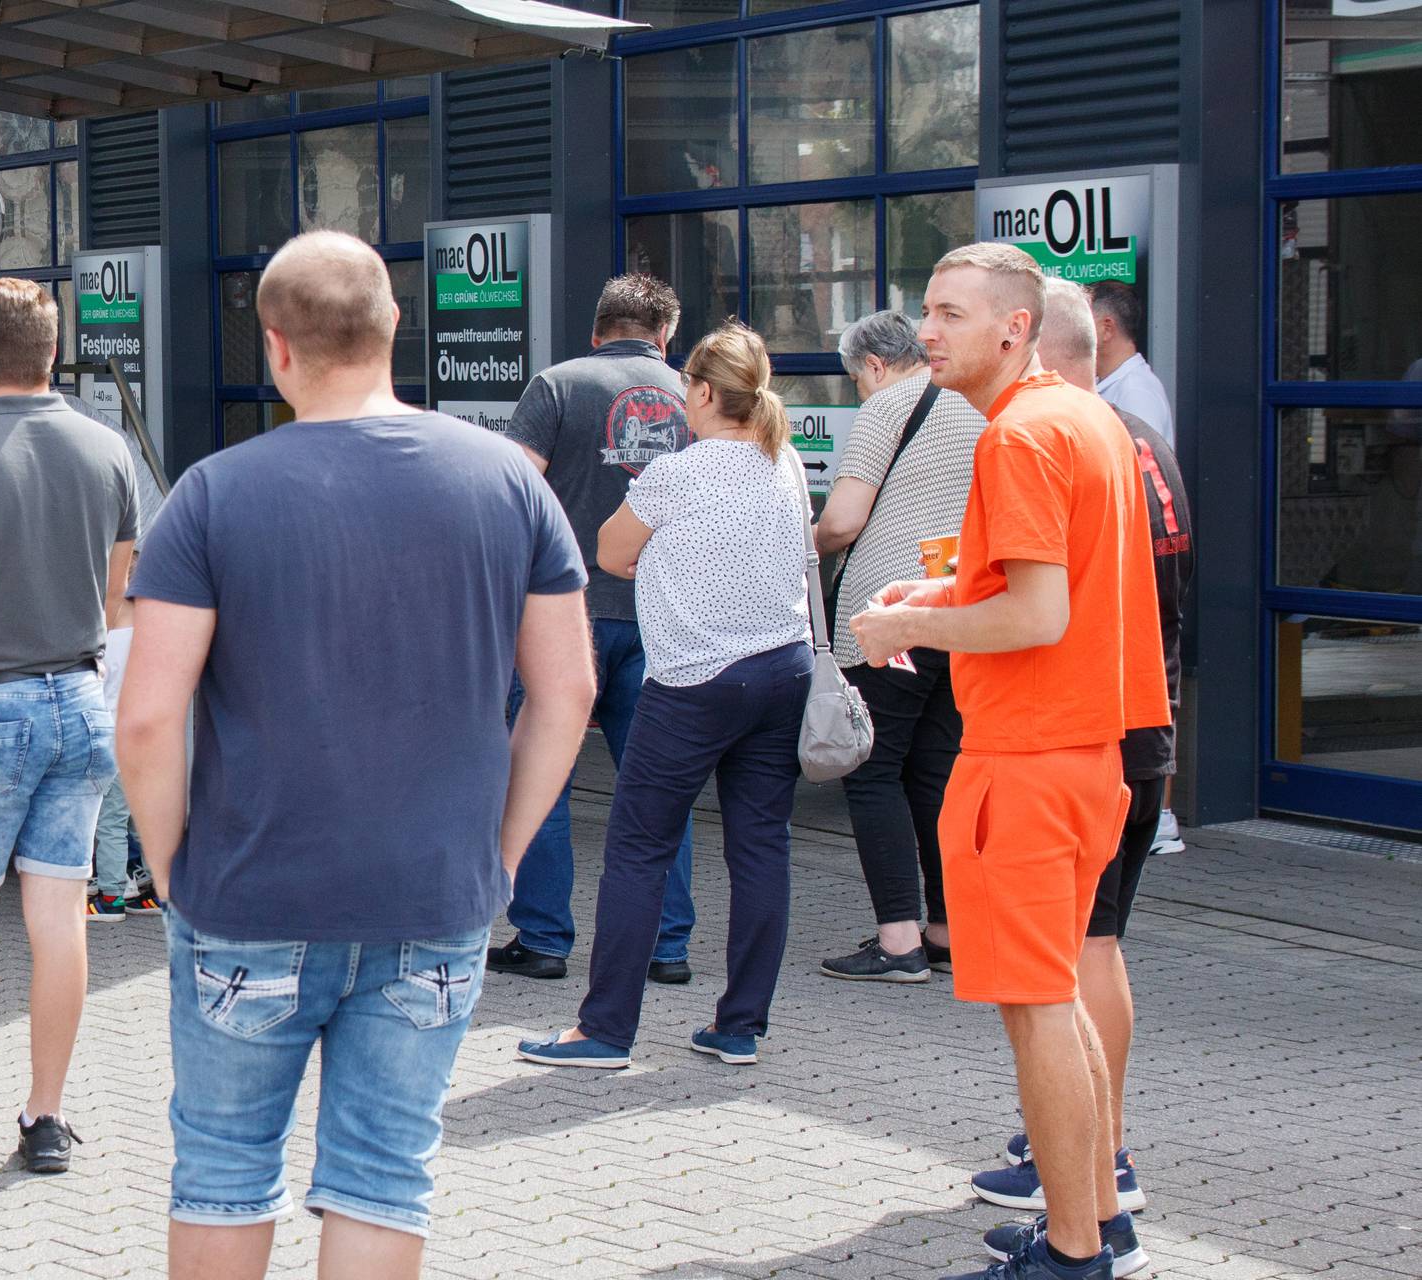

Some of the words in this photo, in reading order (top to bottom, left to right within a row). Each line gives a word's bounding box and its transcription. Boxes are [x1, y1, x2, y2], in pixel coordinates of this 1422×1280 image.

[1065, 262, 1131, 279] ÖLWECHSEL
[439, 294, 453, 304] DER
[454, 290, 478, 303] GRÜNE
[480, 290, 519, 303] ÖLWECHSEL
[437, 328, 523, 343] umweltfreundlicher
[80, 333, 140, 359] Festpreise
[123, 362, 140, 373] SHELL
[438, 349, 523, 381] Ölwechsel
[619, 450, 631, 461] WE
[634, 450, 663, 461] SALUT
